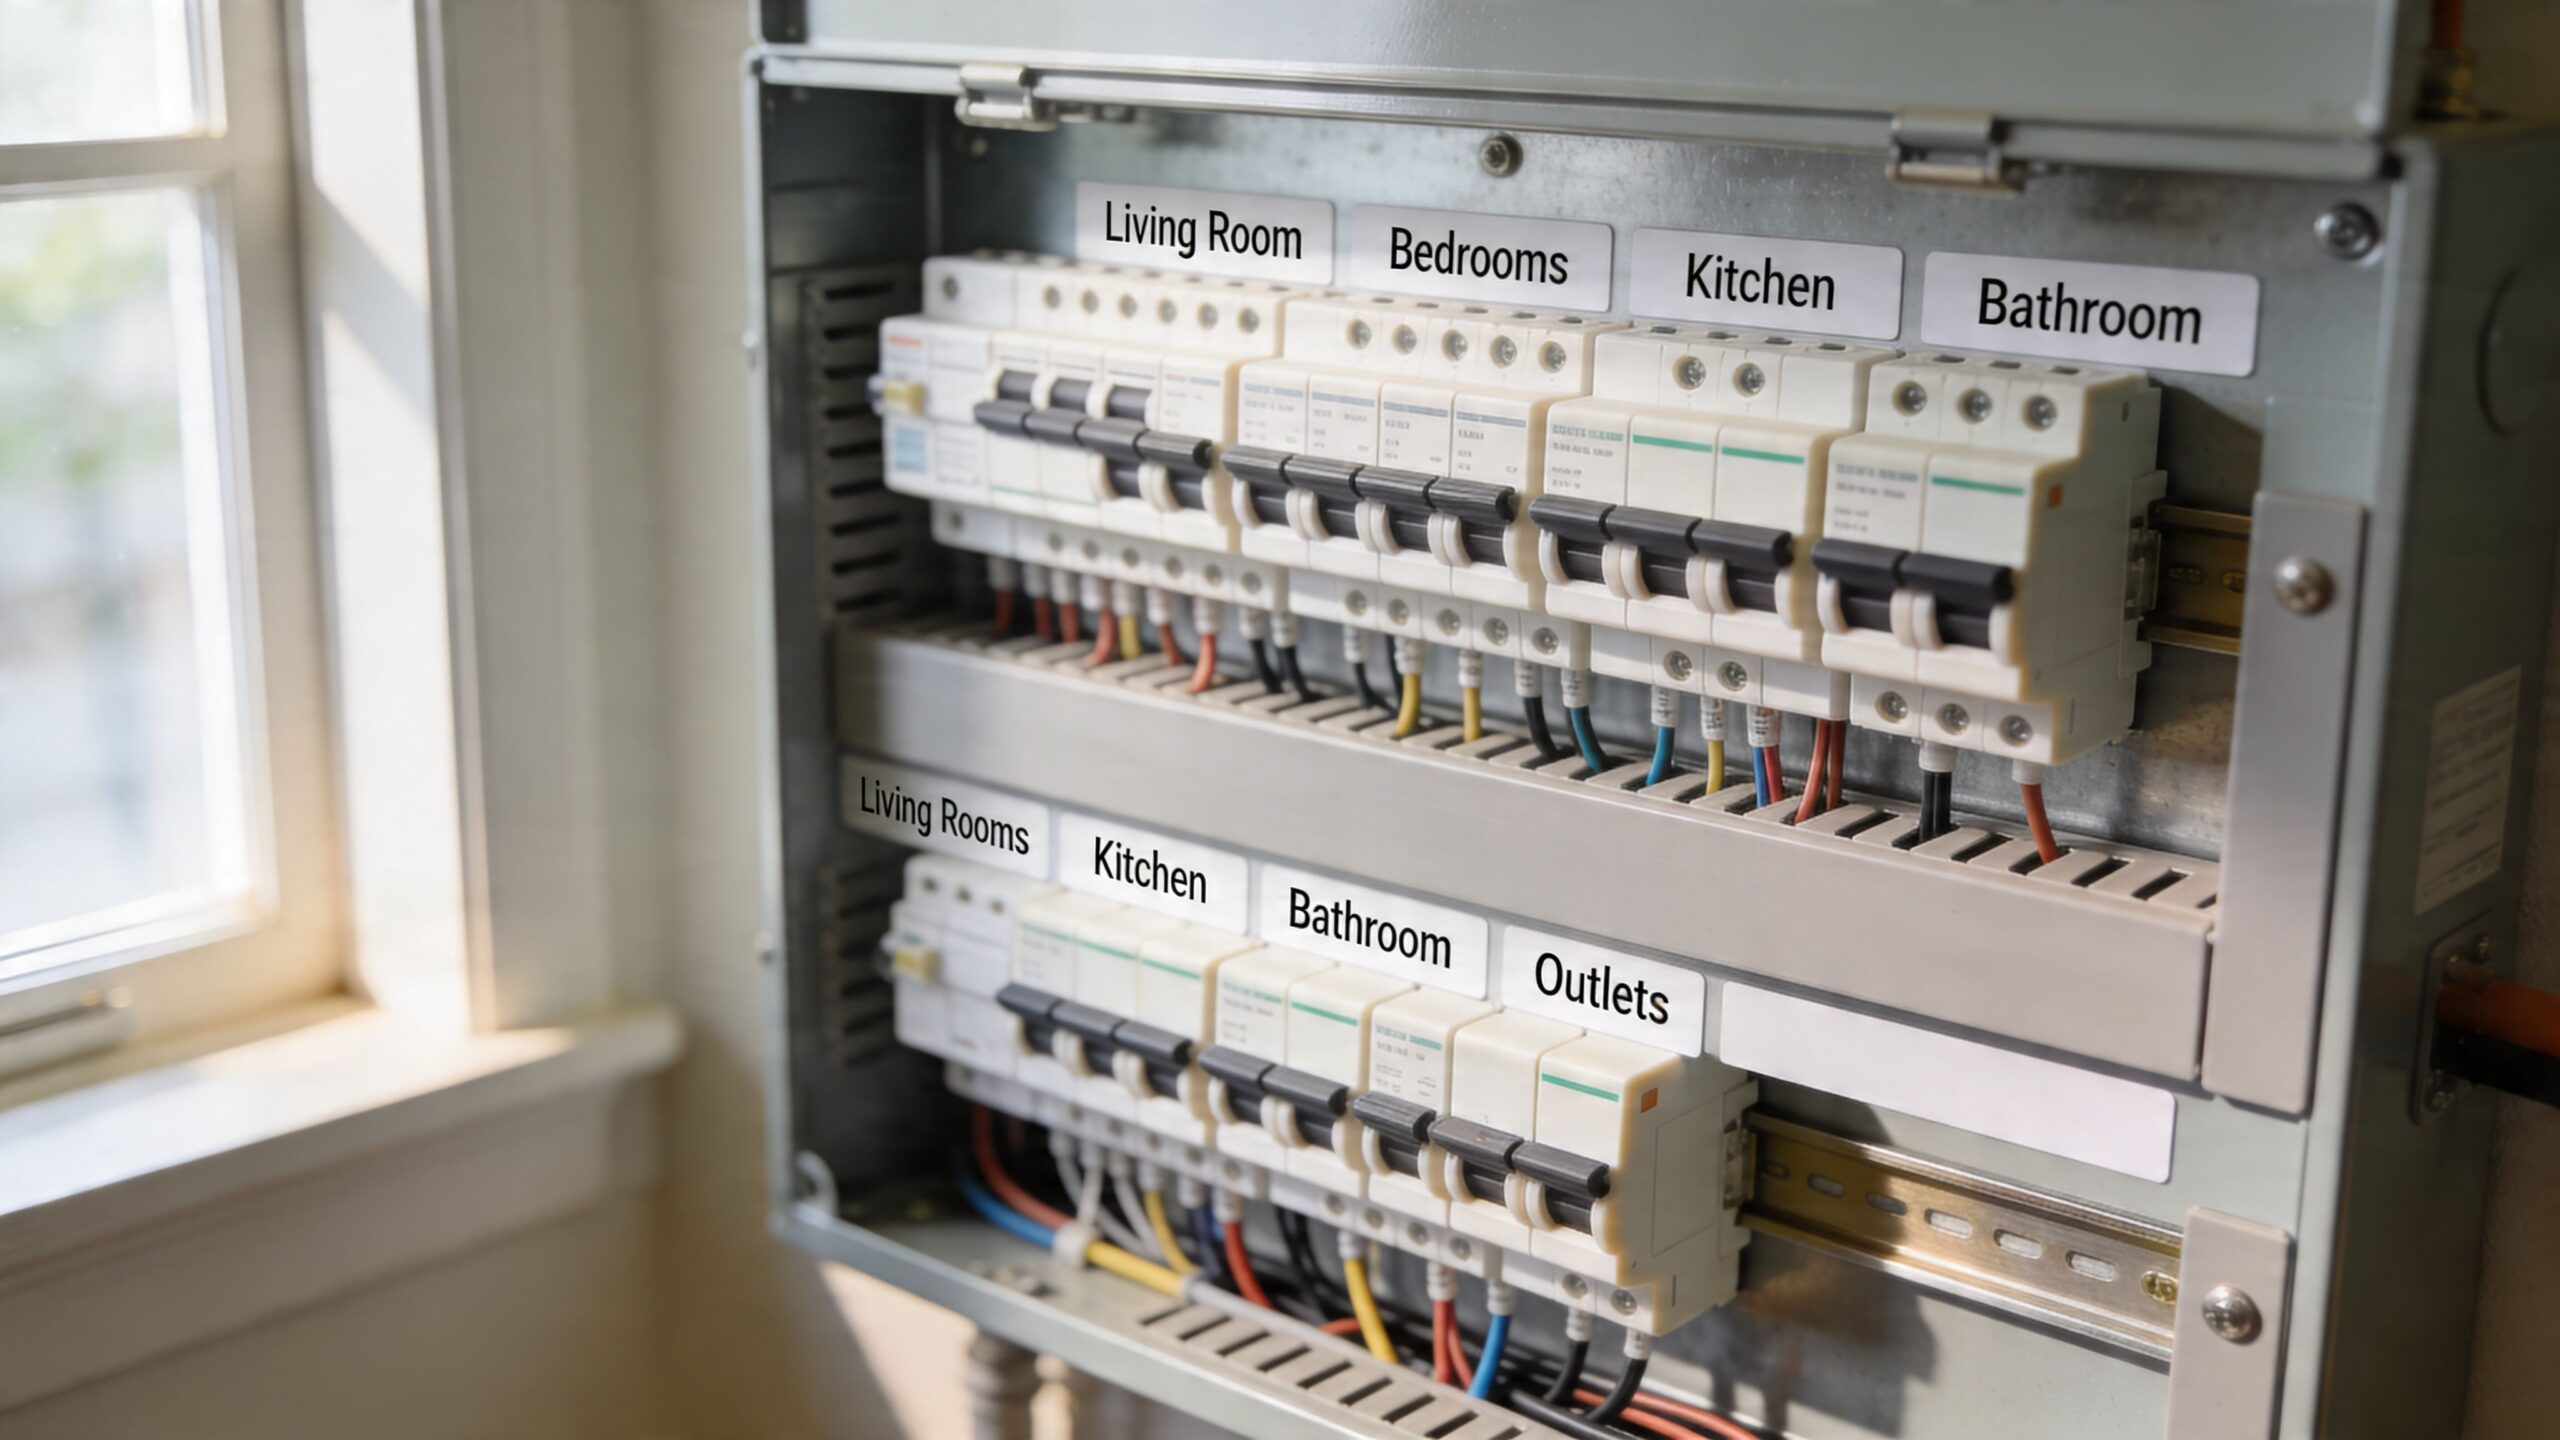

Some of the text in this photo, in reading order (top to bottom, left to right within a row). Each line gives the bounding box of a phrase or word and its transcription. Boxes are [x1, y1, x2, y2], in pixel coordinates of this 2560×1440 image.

[1106, 201, 1302, 260] Living Room
[1390, 227, 1569, 285] Bedrooms
[1686, 253, 1835, 310] Kitchen
[1978, 278, 2202, 344] Bathroom
[861, 776, 1030, 855] Living Rooms
[1094, 836, 1207, 904] Kitchen
[1289, 887, 1452, 968] Bathroom
[1535, 951, 1670, 1025] Outlets
